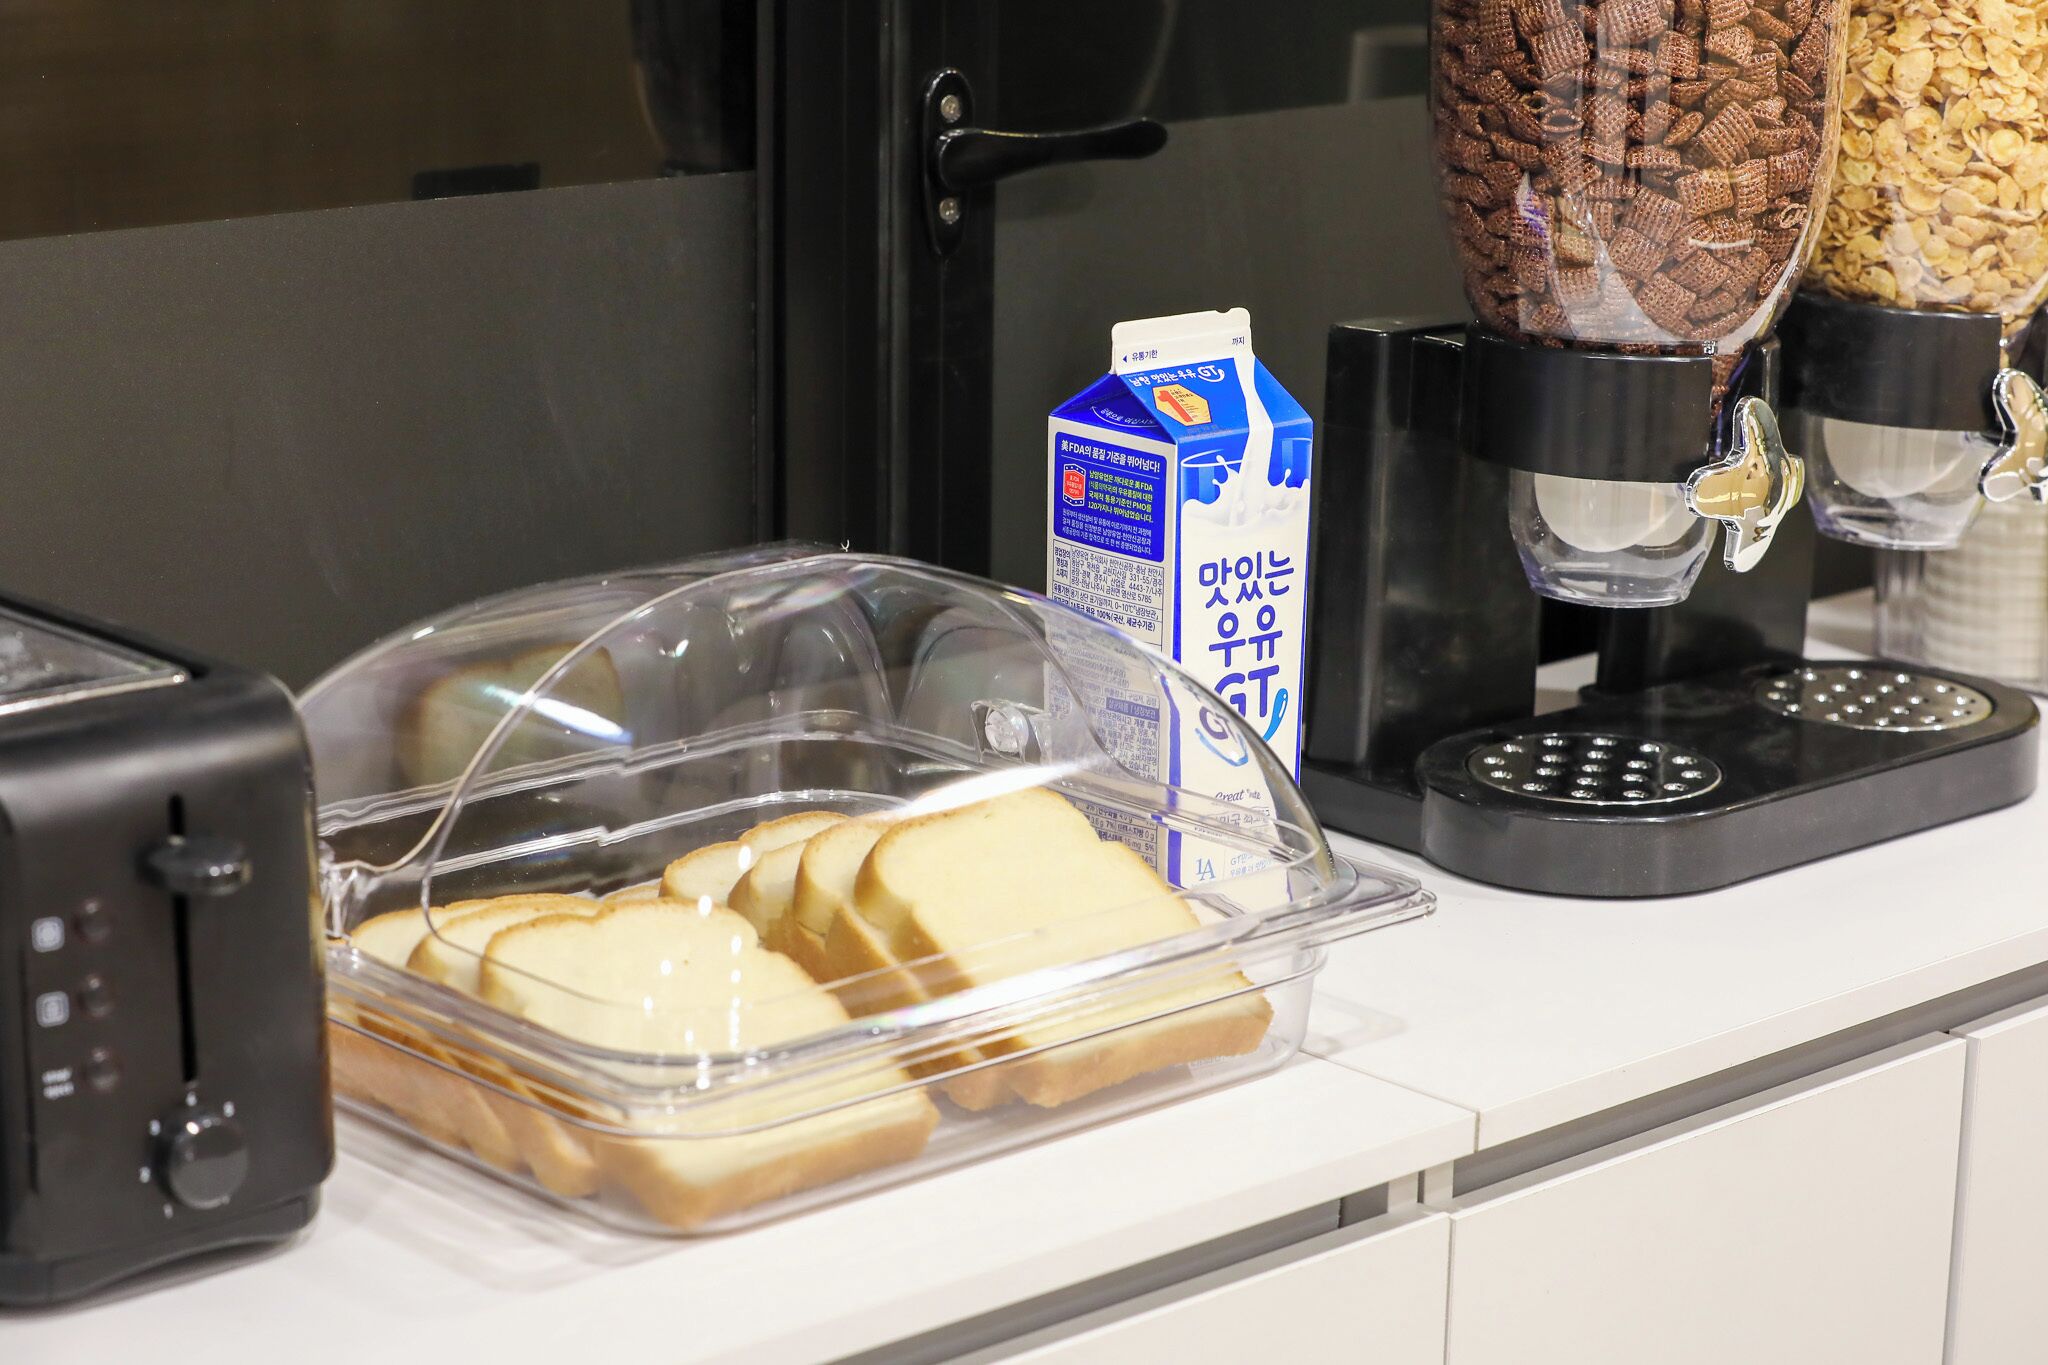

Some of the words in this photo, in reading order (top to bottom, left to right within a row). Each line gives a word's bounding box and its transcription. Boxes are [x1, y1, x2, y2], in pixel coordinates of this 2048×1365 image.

[1231, 336, 1245, 346] 까지
[1132, 349, 1158, 362] 유통기한
[1129, 376, 1151, 387] 남양
[1151, 373, 1179, 384] 맛있는
[1178, 369, 1197, 380] 우유
[1092, 446, 1106, 461] 품질
[1106, 451, 1127, 465] 기준을
[1127, 455, 1160, 472] 뛰어넘다!
[1089, 470, 1114, 483] 남양유업은
[1199, 550, 1294, 609] 맛있는
[1208, 604, 1283, 667] 우유
[1214, 664, 1280, 719] GT
